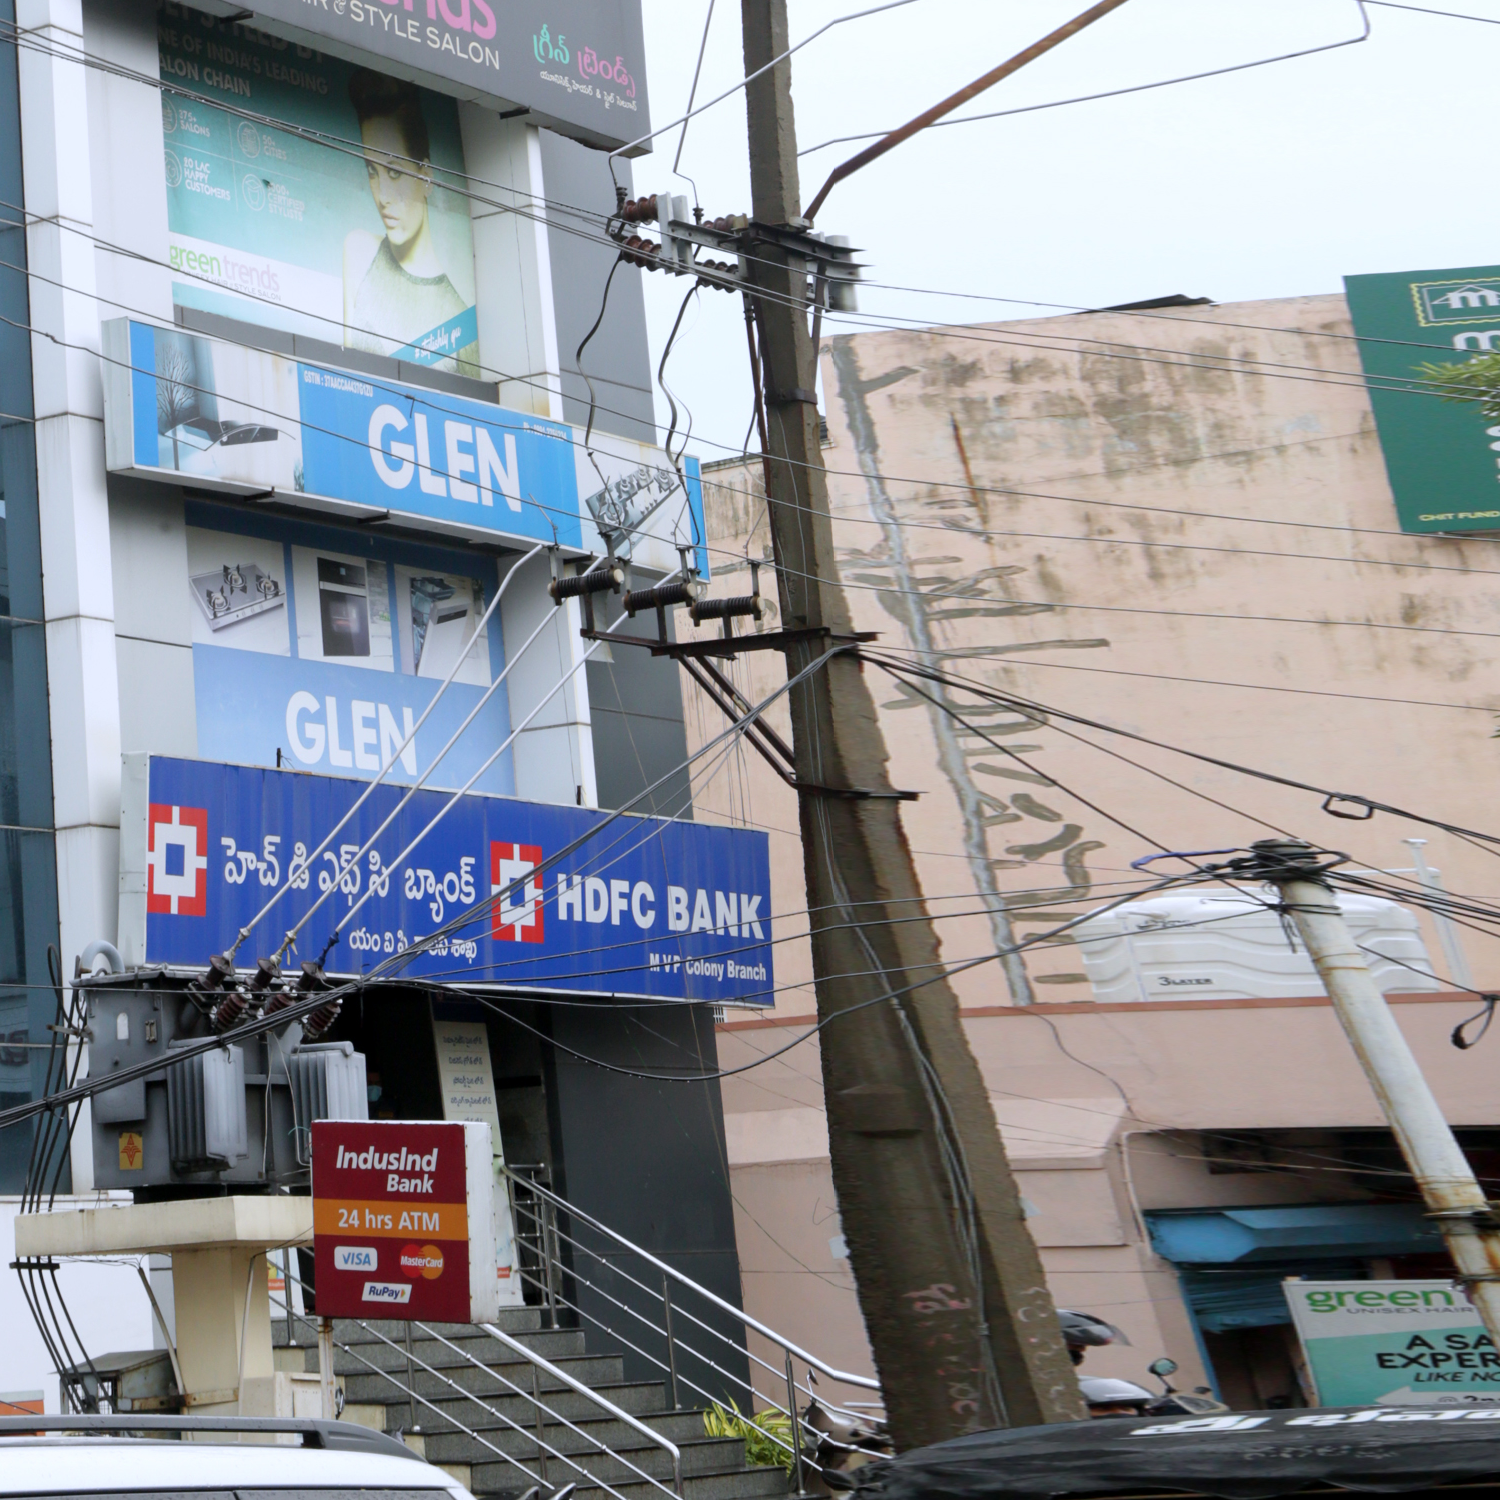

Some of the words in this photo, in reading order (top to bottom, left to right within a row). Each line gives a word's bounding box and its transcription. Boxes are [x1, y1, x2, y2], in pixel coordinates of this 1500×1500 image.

[350, 0, 421, 43] STYLE
[426, 26, 500, 70] SALON
[182, 34, 202, 55] OF
[265, 60, 328, 95] LEADING
[203, 67, 251, 98] CHAIN
[180, 120, 211, 138] SALONS
[264, 145, 287, 161] CITIES
[183, 156, 193, 169] 20
[194, 158, 211, 175] LAC
[184, 168, 209, 184] HAPPY
[185, 179, 232, 202] CUSTOMERS
[267, 191, 306, 211] CERTIFIED
[268, 203, 304, 222] STYLISTS
[169, 245, 222, 274] green
[223, 254, 281, 293] trends
[304, 369, 320, 386] GSTIN
[369, 403, 522, 513] GLEN
[286, 690, 418, 776] GLEN
[557, 873, 656, 930] HDFC
[667, 885, 765, 940] BANK
[686, 956, 725, 982] Colony
[727, 959, 767, 981] Branch
[336, 1145, 438, 1172] IndusInd
[386, 1174, 434, 1194] Bank
[338, 1208, 360, 1228] 24
[365, 1211, 393, 1230] hrs
[398, 1211, 440, 1232] ATM
[342, 1252, 371, 1267] VISA
[400, 1254, 443, 1269] MasterCard
[368, 1285, 401, 1300] RuPay
[1305, 1289, 1455, 1314] green
[1346, 1307, 1421, 1315] UNISEX
[1426, 1306, 1474, 1314] HAIR
[1406, 1334, 1435, 1350] A
[1376, 1352, 1500, 1369] EXPER
[1414, 1372, 1465, 1382] LIKE
